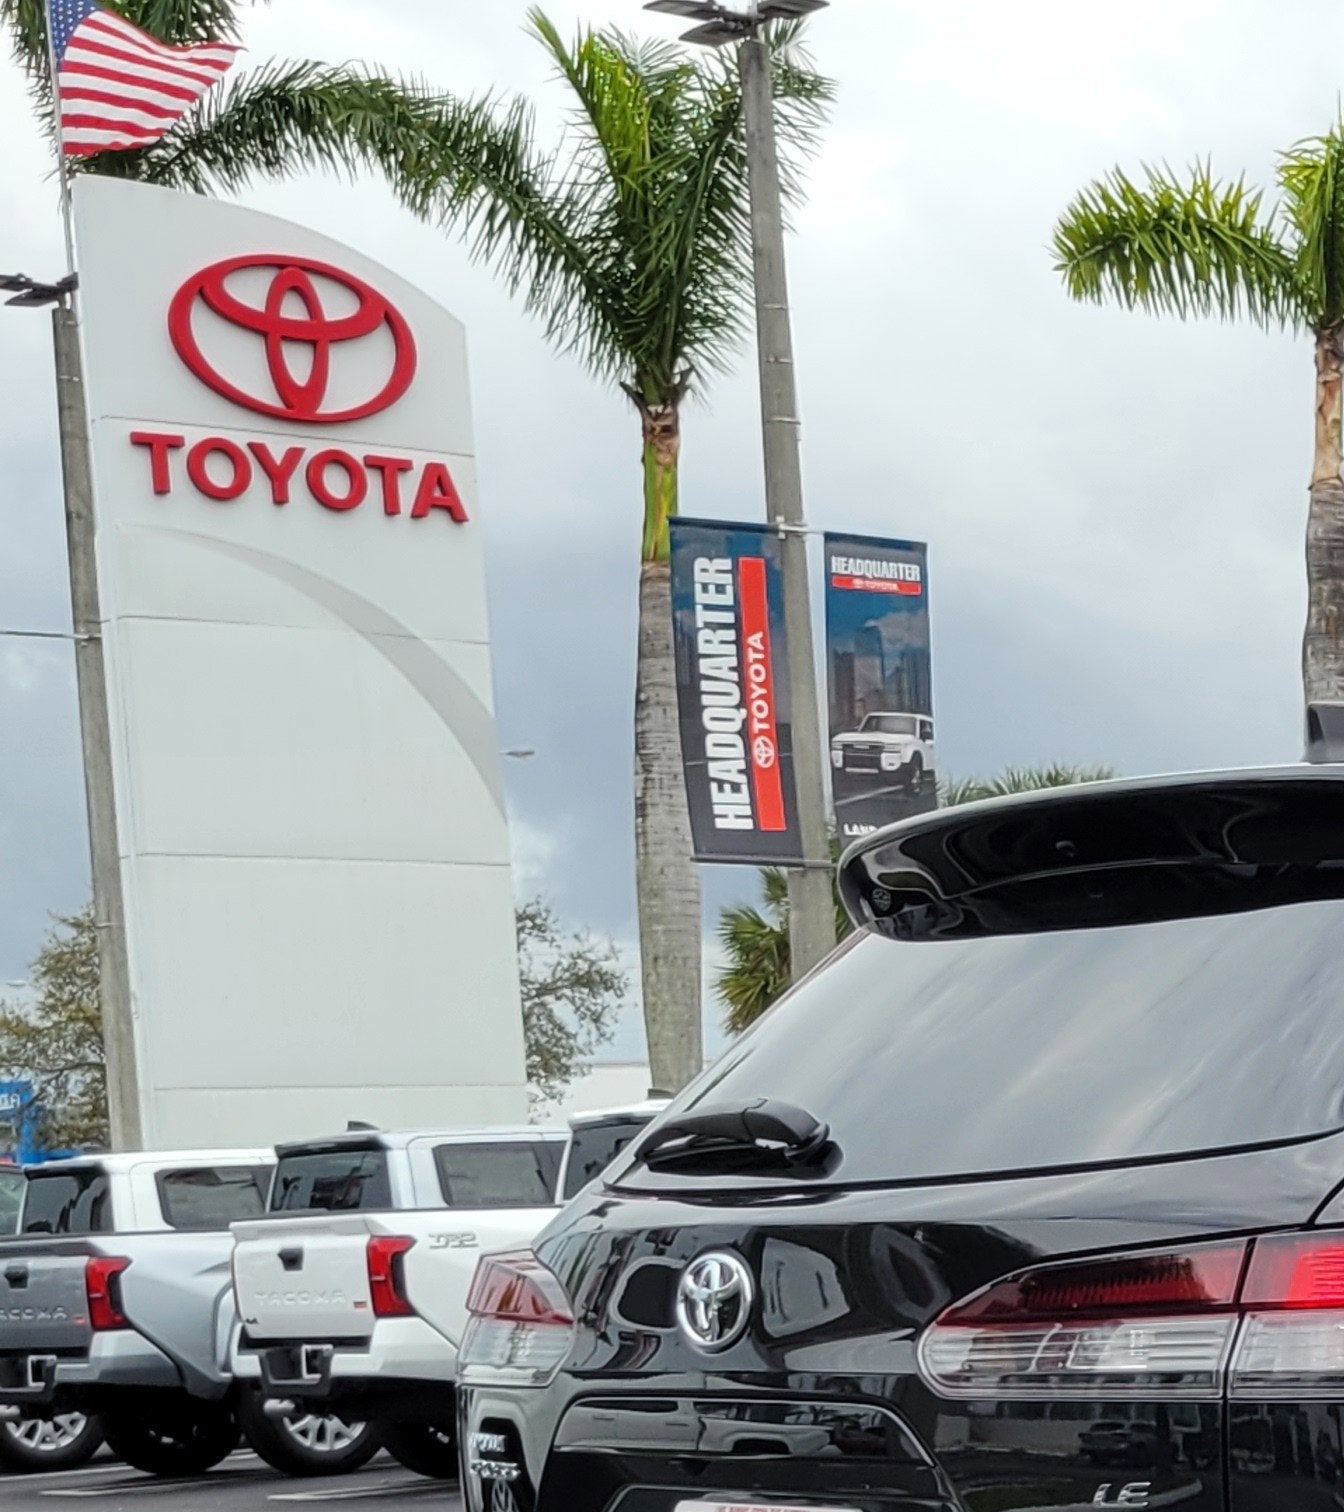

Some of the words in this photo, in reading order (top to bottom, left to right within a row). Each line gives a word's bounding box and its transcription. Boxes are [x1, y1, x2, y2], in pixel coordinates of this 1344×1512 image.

[130, 431, 469, 522] TOYOTA
[831, 555, 920, 581] HEADQUARTER
[693, 556, 755, 831] HEADQUARTER
[747, 631, 771, 735] TOYOTA
[253, 1290, 346, 1306] TACOMA
[1093, 1481, 1152, 1508] LE
